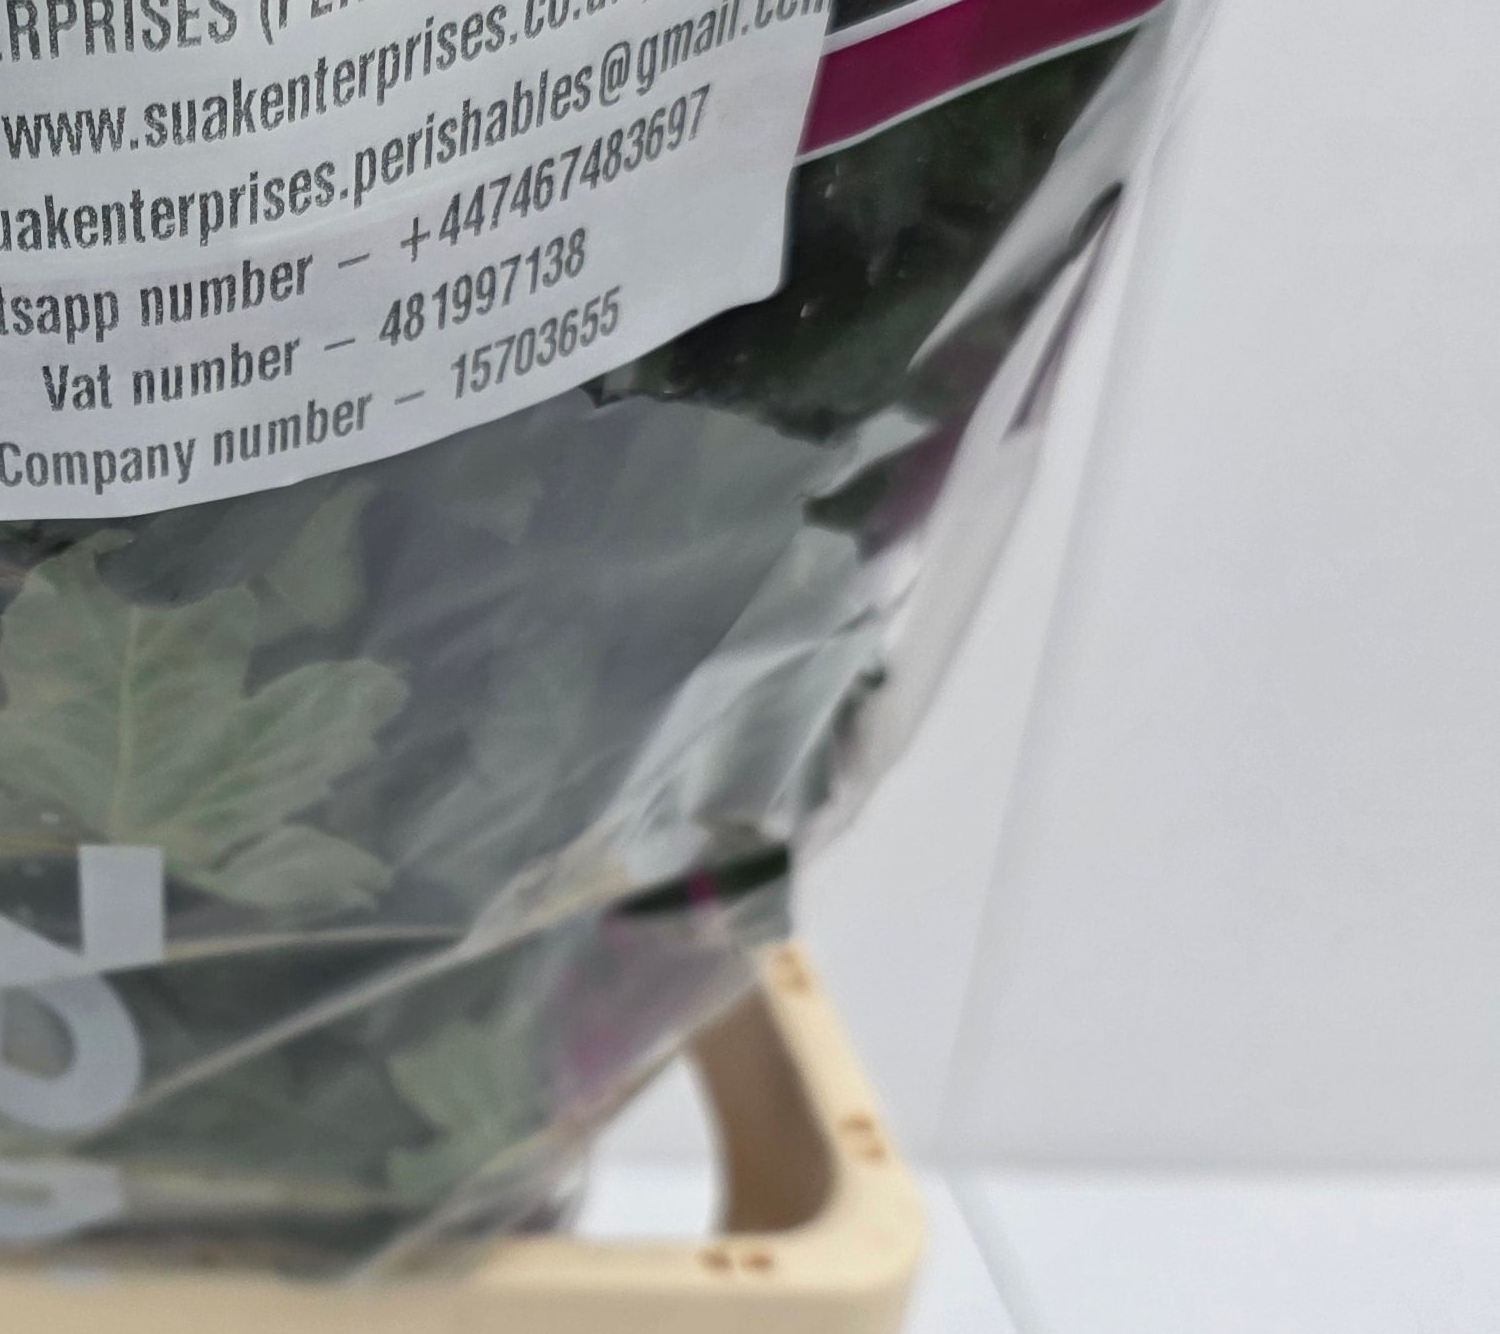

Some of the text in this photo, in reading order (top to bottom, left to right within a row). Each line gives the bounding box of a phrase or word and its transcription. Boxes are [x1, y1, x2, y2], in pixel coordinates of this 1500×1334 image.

[140, 254, 314, 329] number
[399, 84, 712, 264] +447467483697
[41, 363, 114, 414] Vat
[132, 335, 300, 406] number
[379, 227, 588, 347] 481997138
[212, 390, 373, 467] number
[451, 285, 624, 400] 15703655
